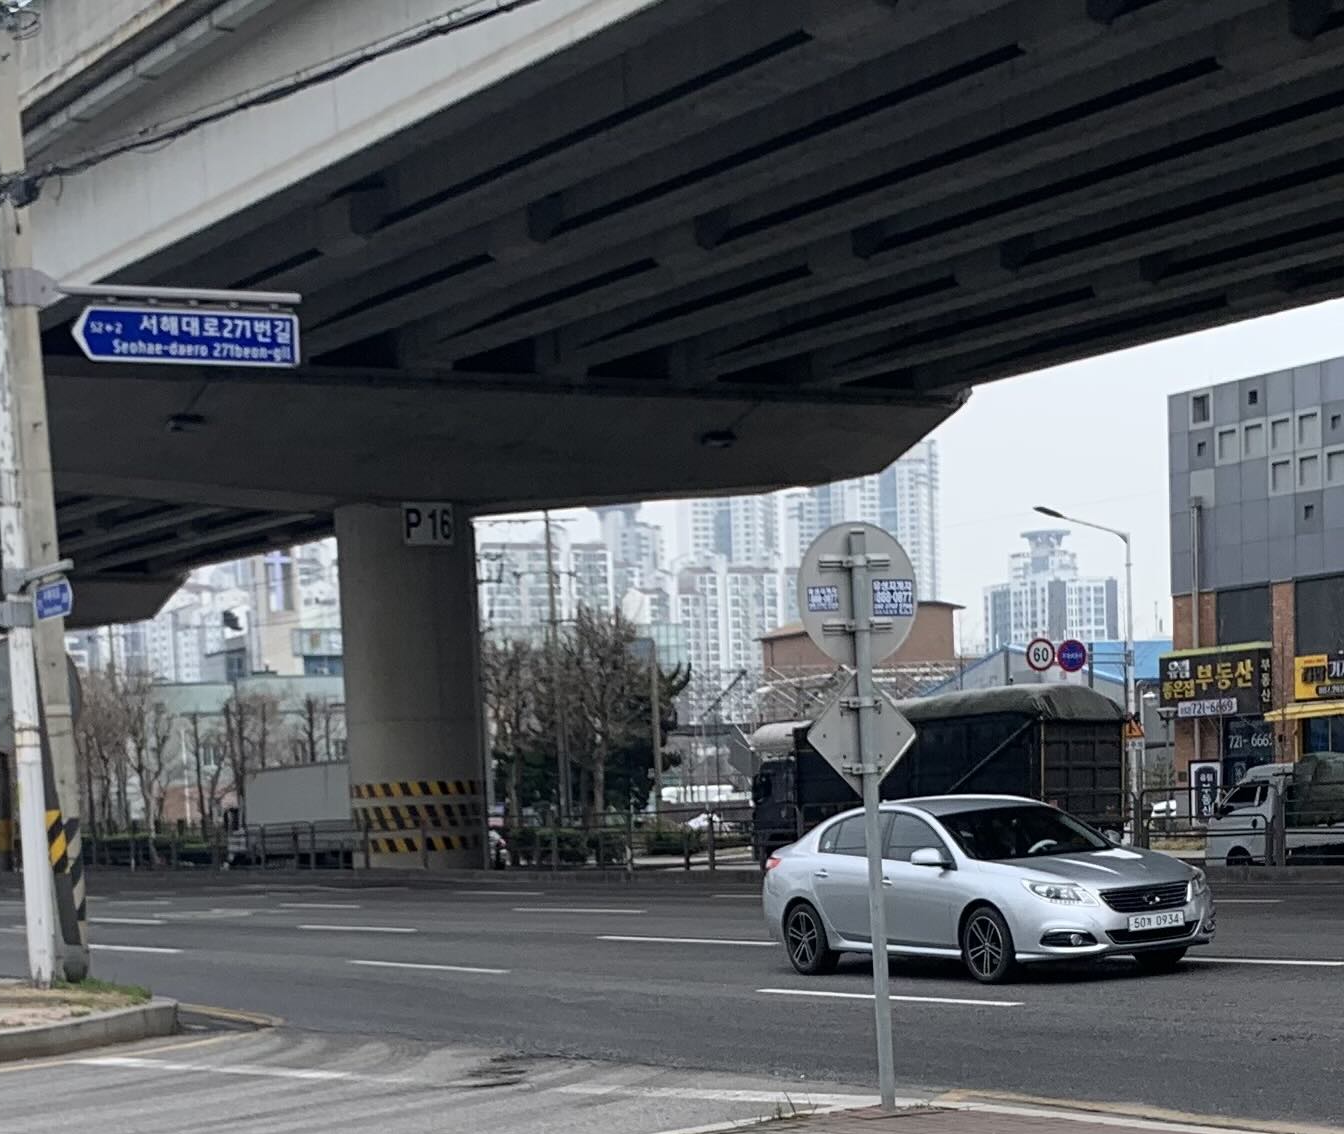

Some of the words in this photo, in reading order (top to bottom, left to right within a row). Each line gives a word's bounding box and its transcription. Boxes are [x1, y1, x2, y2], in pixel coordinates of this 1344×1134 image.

[139, 314, 291, 344] 서해대로271번길
[112, 338, 208, 356] Seohae-daero
[1033, 647, 1049, 662] 60
[1167, 659, 1191, 679] 유림
[1196, 659, 1253, 691] 부동산
[1162, 680, 1195, 699] 좋은집
[1261, 659, 1270, 702] 부동산
